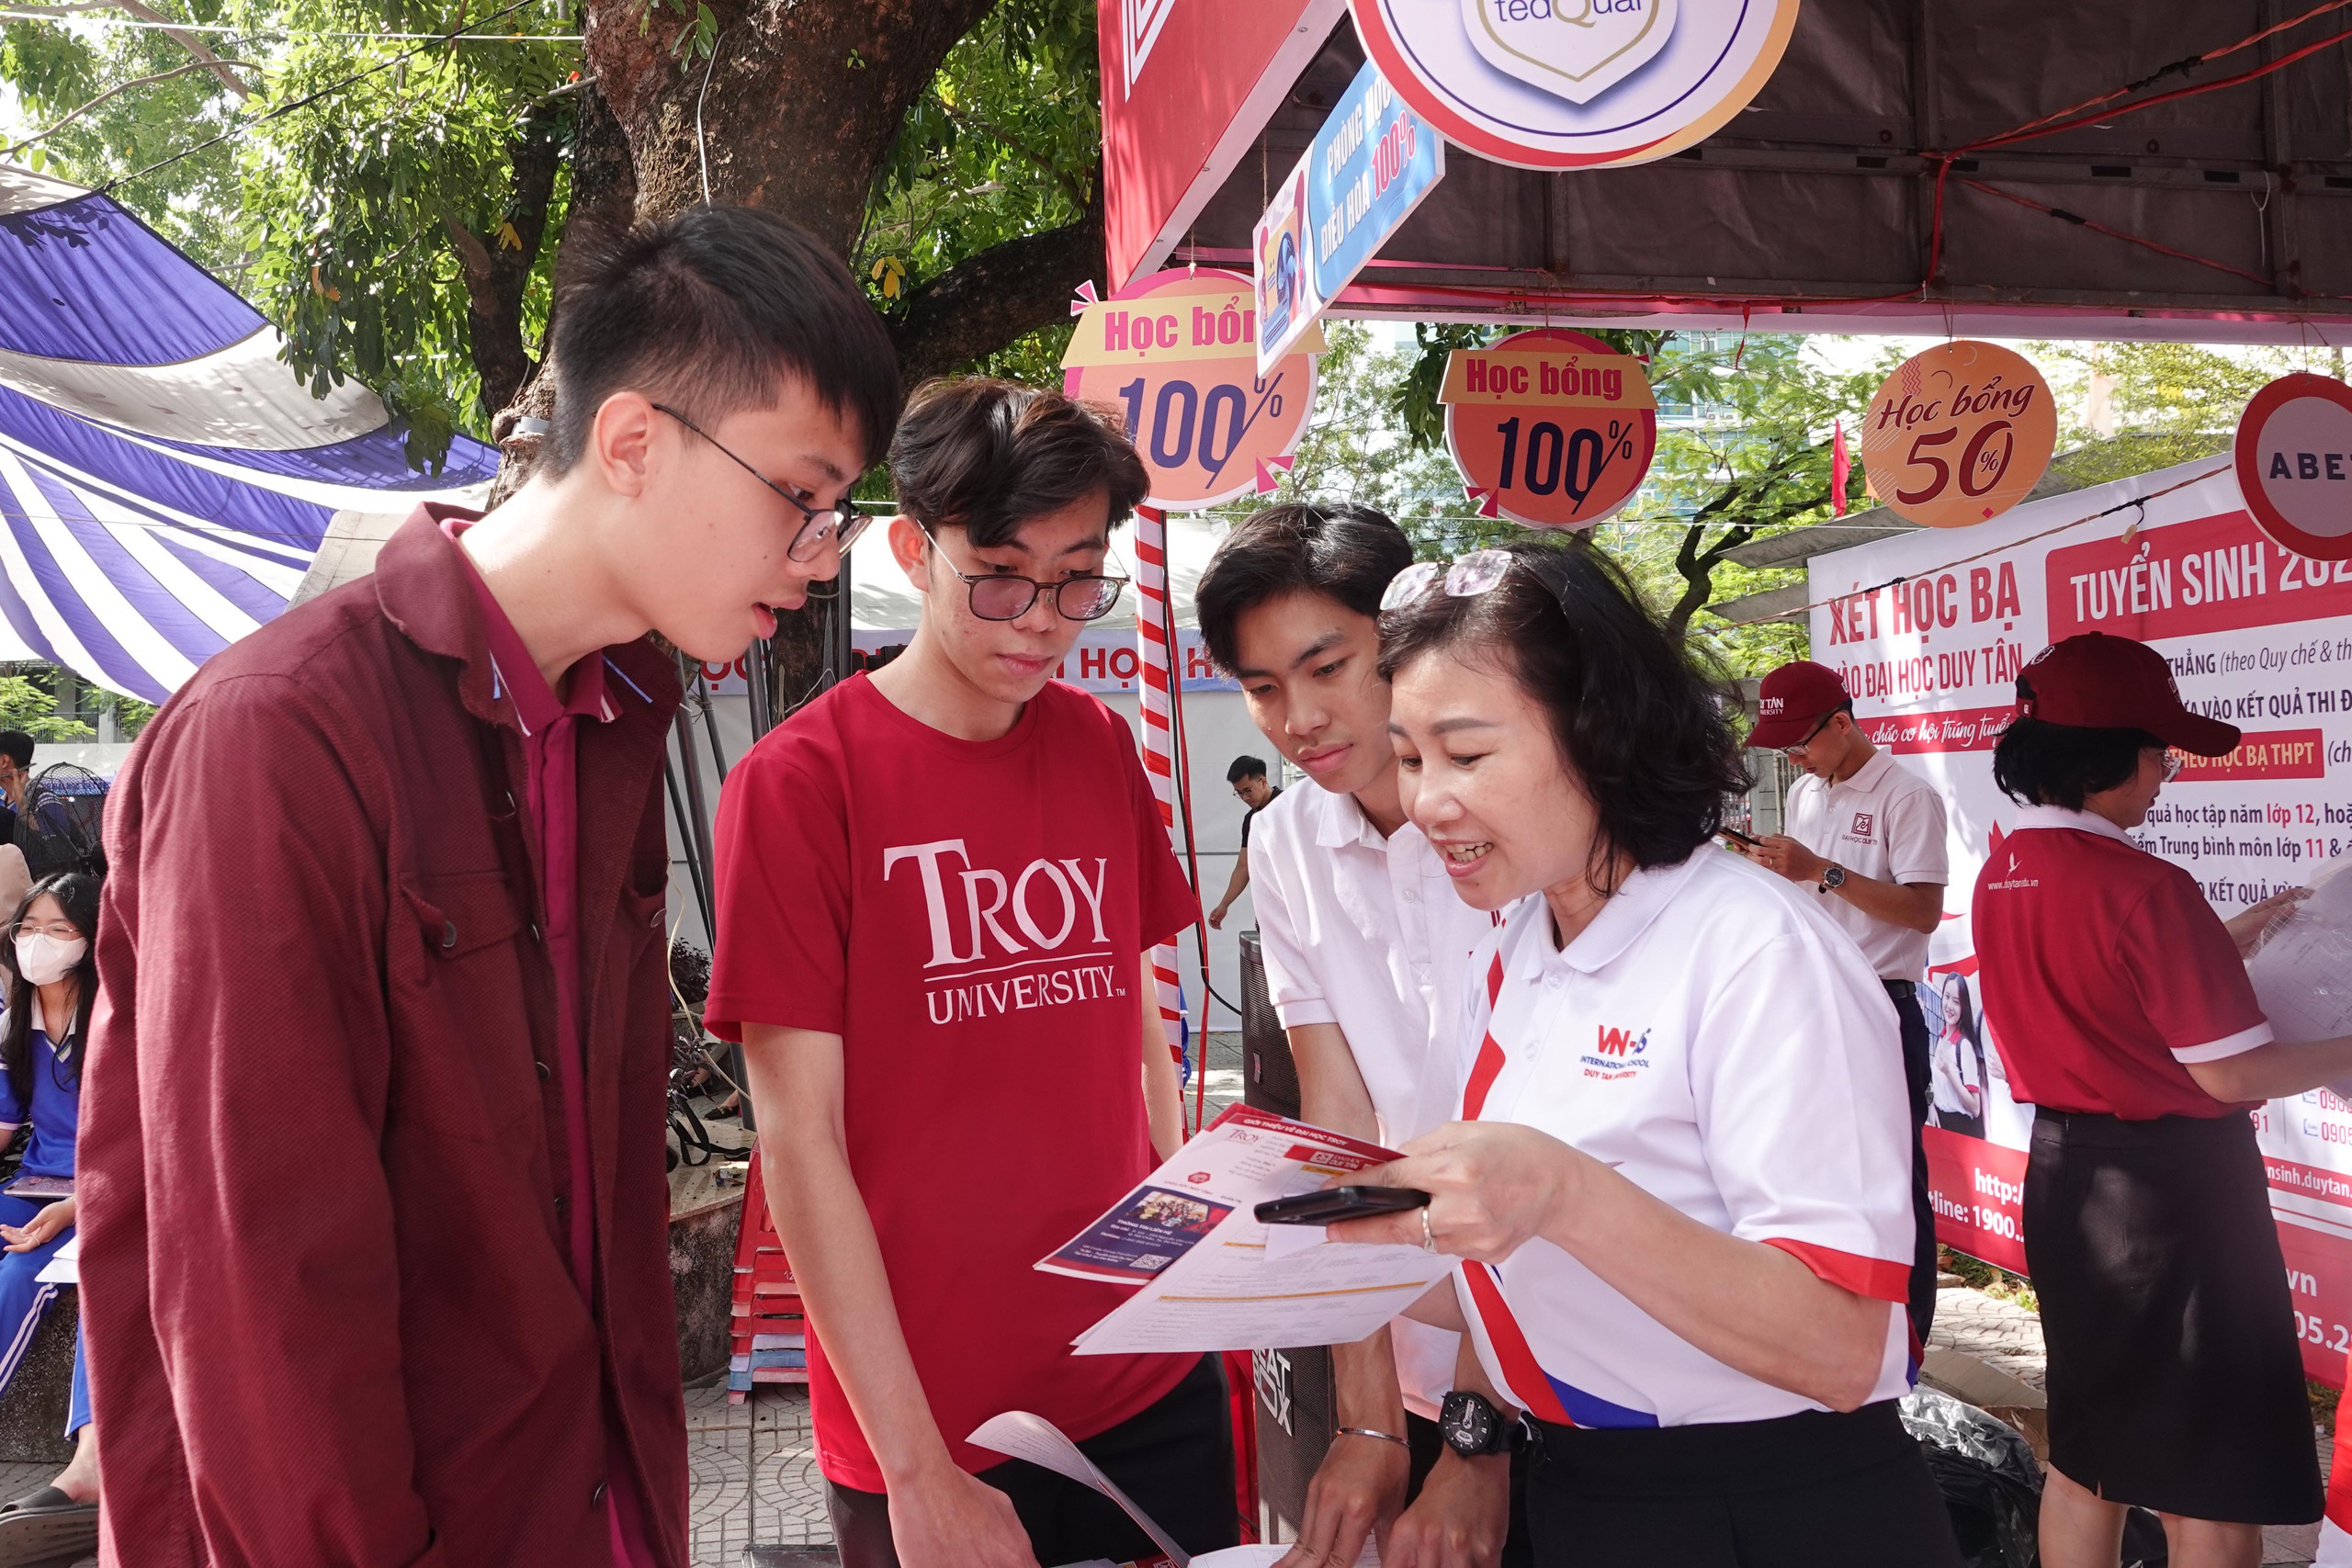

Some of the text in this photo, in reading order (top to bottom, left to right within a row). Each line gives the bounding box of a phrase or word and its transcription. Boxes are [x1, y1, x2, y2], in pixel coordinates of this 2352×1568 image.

[1326, 102, 1364, 186] PHÒNG
[1320, 109, 1417, 265] ĐIỀU HÒA 100%
[1104, 296, 1257, 357] Học bổn
[1465, 355, 1623, 401] Học bổng
[1876, 376, 2036, 431] Học bổng
[1118, 372, 1284, 490] 100%
[1497, 417, 1634, 515] 100%
[2269, 452, 2352, 480] ABE
[2071, 542, 2173, 622] TUYỂN
[2181, 541, 2267, 606] SINH
[1829, 561, 2022, 646] XÉT HỌC BẠ
[1080, 647, 1140, 689] HỌ
[1837, 637, 2022, 704] ÀO ĐẠI HỌC DUY TÂN
[2166, 649, 2215, 677] THẲNG
[2220, 650, 2256, 676] (theo
[2259, 647, 2288, 672] Quy
[2290, 639, 2319, 666] chế
[2320, 640, 2333, 662] &
[1766, 697, 1785, 709] TÂN
[2202, 695, 2233, 720] VÀO
[2236, 690, 2265, 719] KẾT
[2268, 687, 2304, 718] QUẢ
[2306, 691, 2336, 714] THI
[1871, 721, 1900, 745] chắc
[1901, 727, 1917, 742] cơ
[1917, 718, 1940, 744] hội
[1978, 713, 2012, 748] tuyể
[2246, 744, 2269, 773] BẠ
[2270, 741, 2315, 766] THPT
[2146, 803, 2172, 828] quả
[2176, 805, 2199, 829] học
[2202, 805, 2226, 829] tập
[2230, 804, 2263, 823] năm
[2267, 803, 2291, 829] lớp
[2296, 804, 2321, 827] 12,
[2159, 836, 2199, 860] Trung
[2202, 837, 2235, 856] bình
[2239, 840, 2273, 857] môn
[2277, 837, 2301, 863] lớp
[2305, 838, 2324, 859] 11
[2329, 838, 2342, 858] &
[884, 838, 1111, 968] TROY
[2209, 876, 2234, 902] KẾT
[2238, 878, 2268, 906] QUẢ
[925, 965, 1114, 1024] UNIVERSITY
[1227, 1128, 1263, 1144] TROY
[2265, 1165, 2352, 1199] nsinh.duytan.
[1972, 1205, 2024, 1243] 1900.
